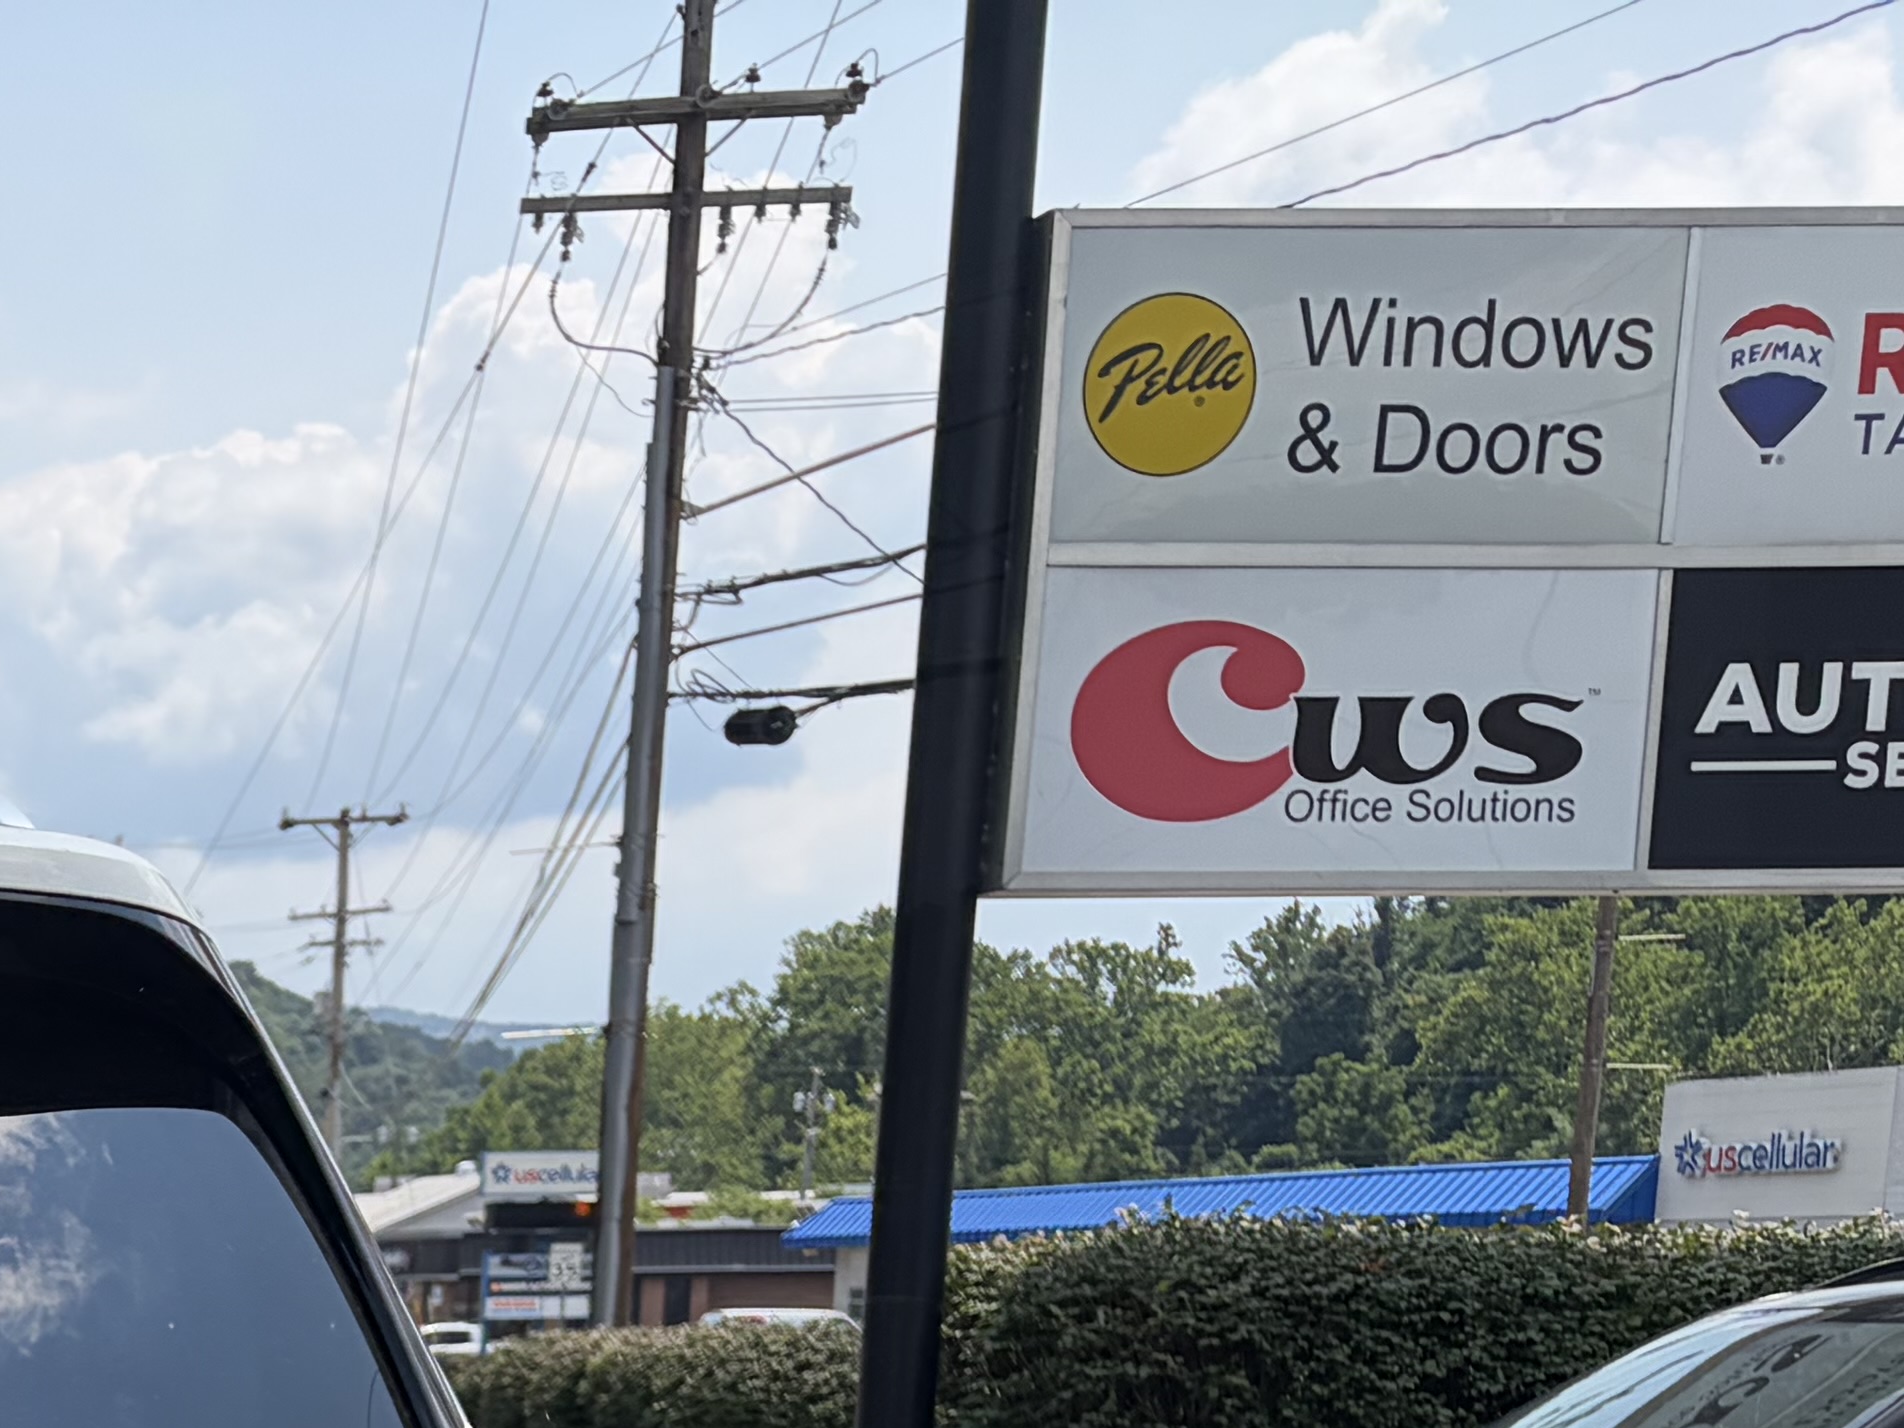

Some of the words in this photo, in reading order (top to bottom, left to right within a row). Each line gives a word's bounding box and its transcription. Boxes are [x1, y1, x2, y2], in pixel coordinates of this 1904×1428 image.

[1300, 297, 1654, 370] Windows
[1730, 341, 1823, 370] RE/MAX
[1097, 332, 1245, 424] Pella
[1287, 402, 1341, 474] &
[1373, 403, 1604, 475] Doors
[1284, 790, 1393, 823] Office
[1406, 790, 1576, 824] Solutions
